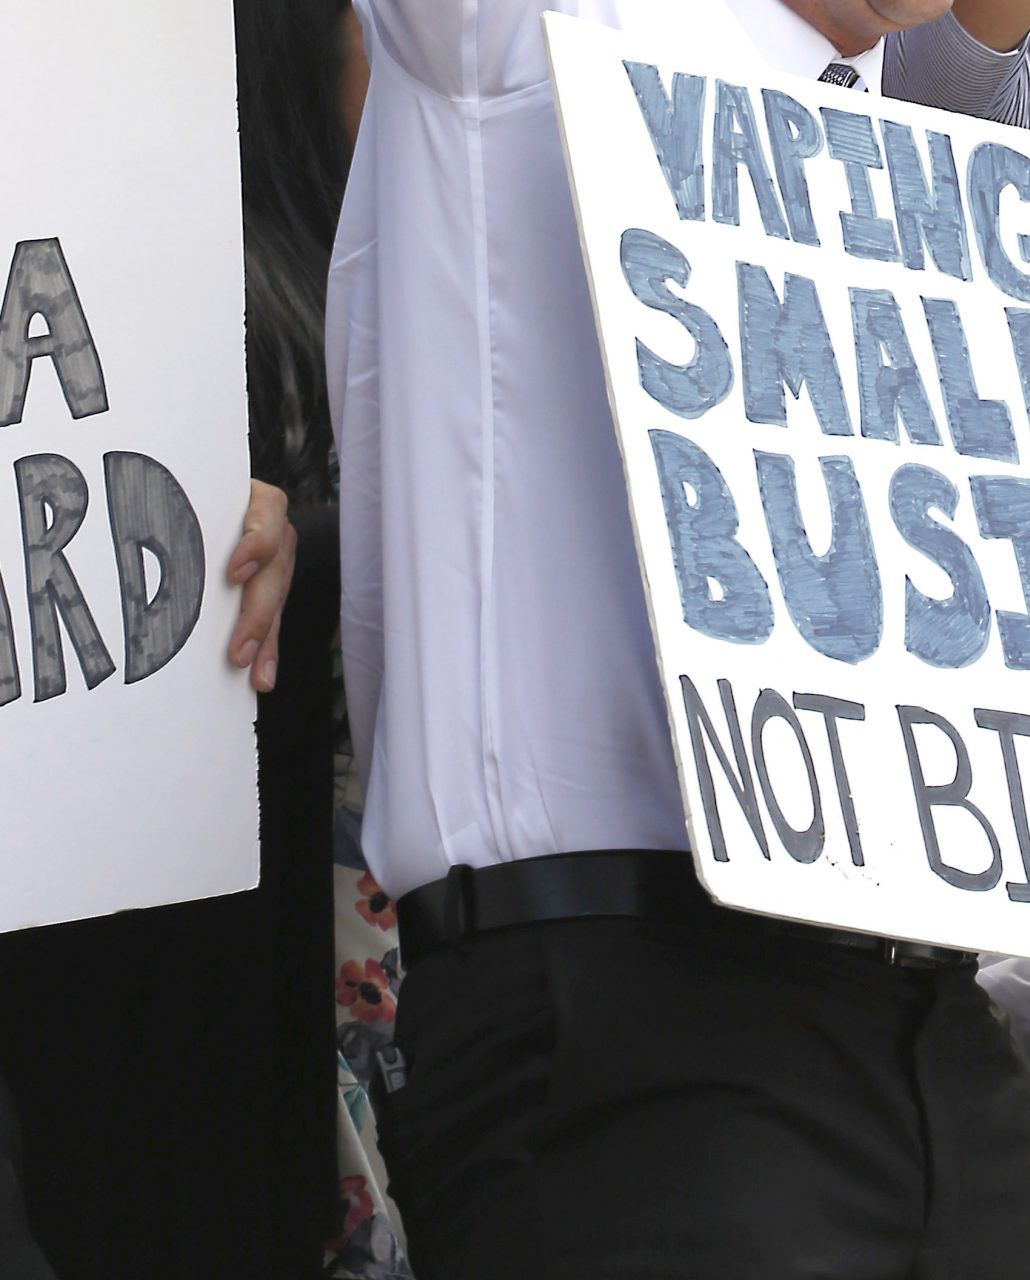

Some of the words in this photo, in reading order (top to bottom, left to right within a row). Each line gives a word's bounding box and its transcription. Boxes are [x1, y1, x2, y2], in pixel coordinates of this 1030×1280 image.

[0, 237, 109, 427] A
[0, 451, 206, 707] RD
[679, 674, 866, 867] NOT
